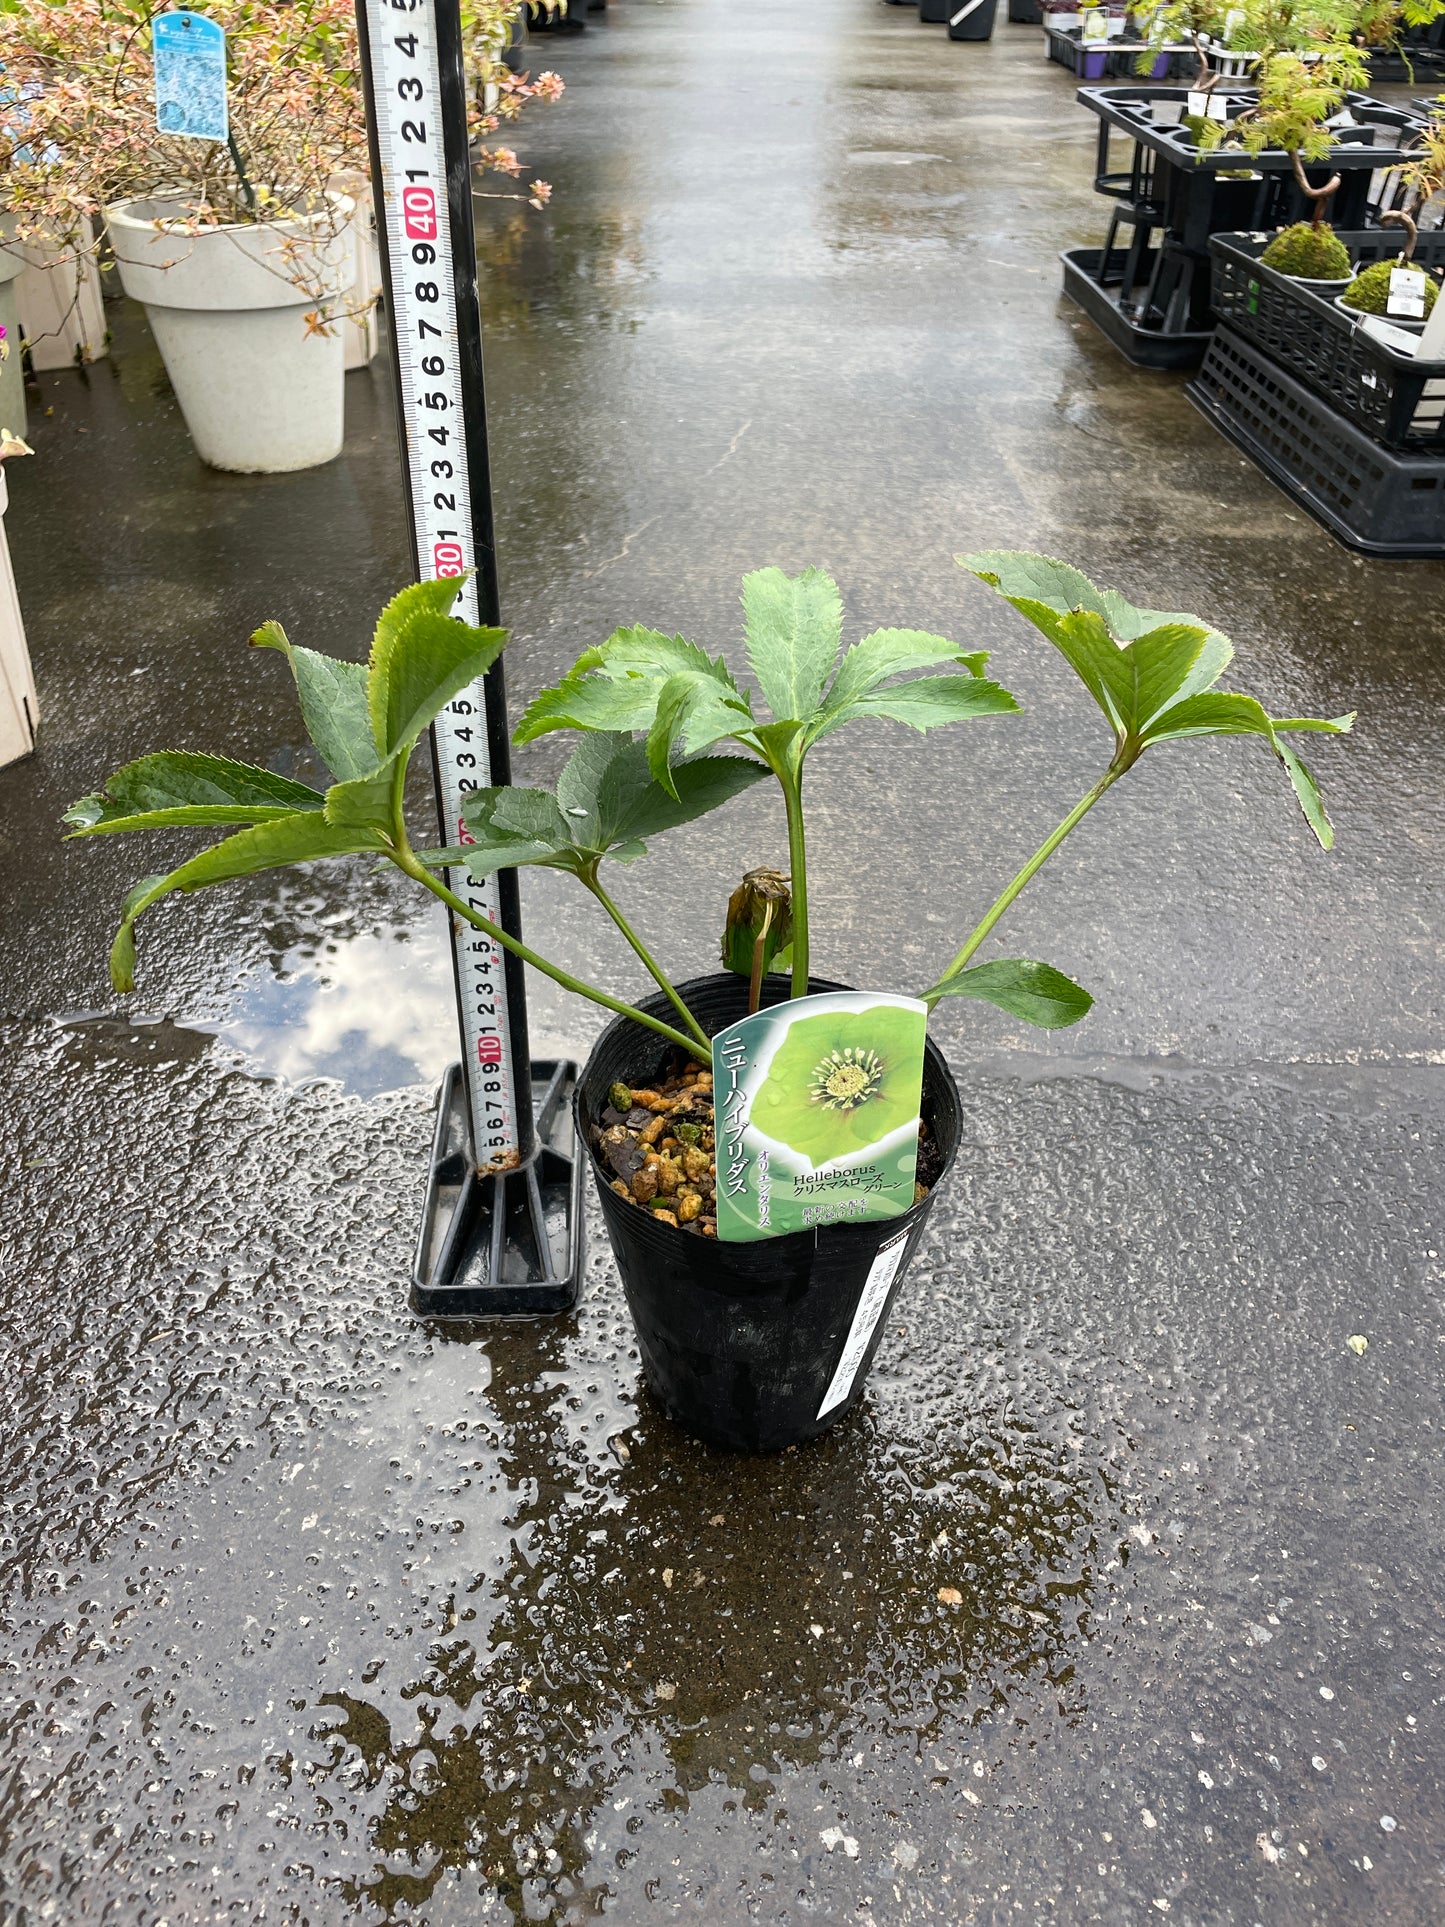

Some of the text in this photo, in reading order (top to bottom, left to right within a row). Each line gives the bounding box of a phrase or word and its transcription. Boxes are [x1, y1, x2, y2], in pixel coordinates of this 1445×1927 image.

[394, 33, 419, 58] 4
[398, 78, 423, 101] 3
[401, 120, 427, 144] 2
[405, 169, 429, 182] 1
[406, 192, 436, 234] 40
[412, 243, 436, 265] 9
[415, 281, 439, 303] 8
[418, 319, 442, 340] 7
[422, 356, 445, 376] 6
[425, 392, 447, 411] 5
[428, 426, 450, 446] 4
[431, 460, 453, 479] 3
[434, 493, 456, 511] 2
[437, 530, 458, 541] 1
[438, 547, 462, 577] 30
[452, 700, 472, 716] 5
[454, 727, 473, 742] 4
[457, 753, 476, 768] 3
[458, 779, 477, 792] 2
[472, 941, 490, 953] 5
[474, 962, 492, 975] 4
[476, 983, 494, 995] 3
[477, 1004, 495, 1015] 2
[480, 1039, 500, 1058] 10
[482, 1062, 500, 1074] 9
[483, 1081, 501, 1093] 8
[486, 1101, 502, 1112] 7
[487, 1118, 503, 1130] 6
[721, 1037, 750, 1198] ニューハイブリダス
[488, 1136, 505, 1147] 5
[489, 1153, 508, 1165] 4
[793, 1164, 876, 1186] Helleborus
[758, 1150, 770, 1227] オリエンタリス
[793, 1172, 886, 1197] クリスマスローズ
[863, 1181, 902, 1194] グリーン
